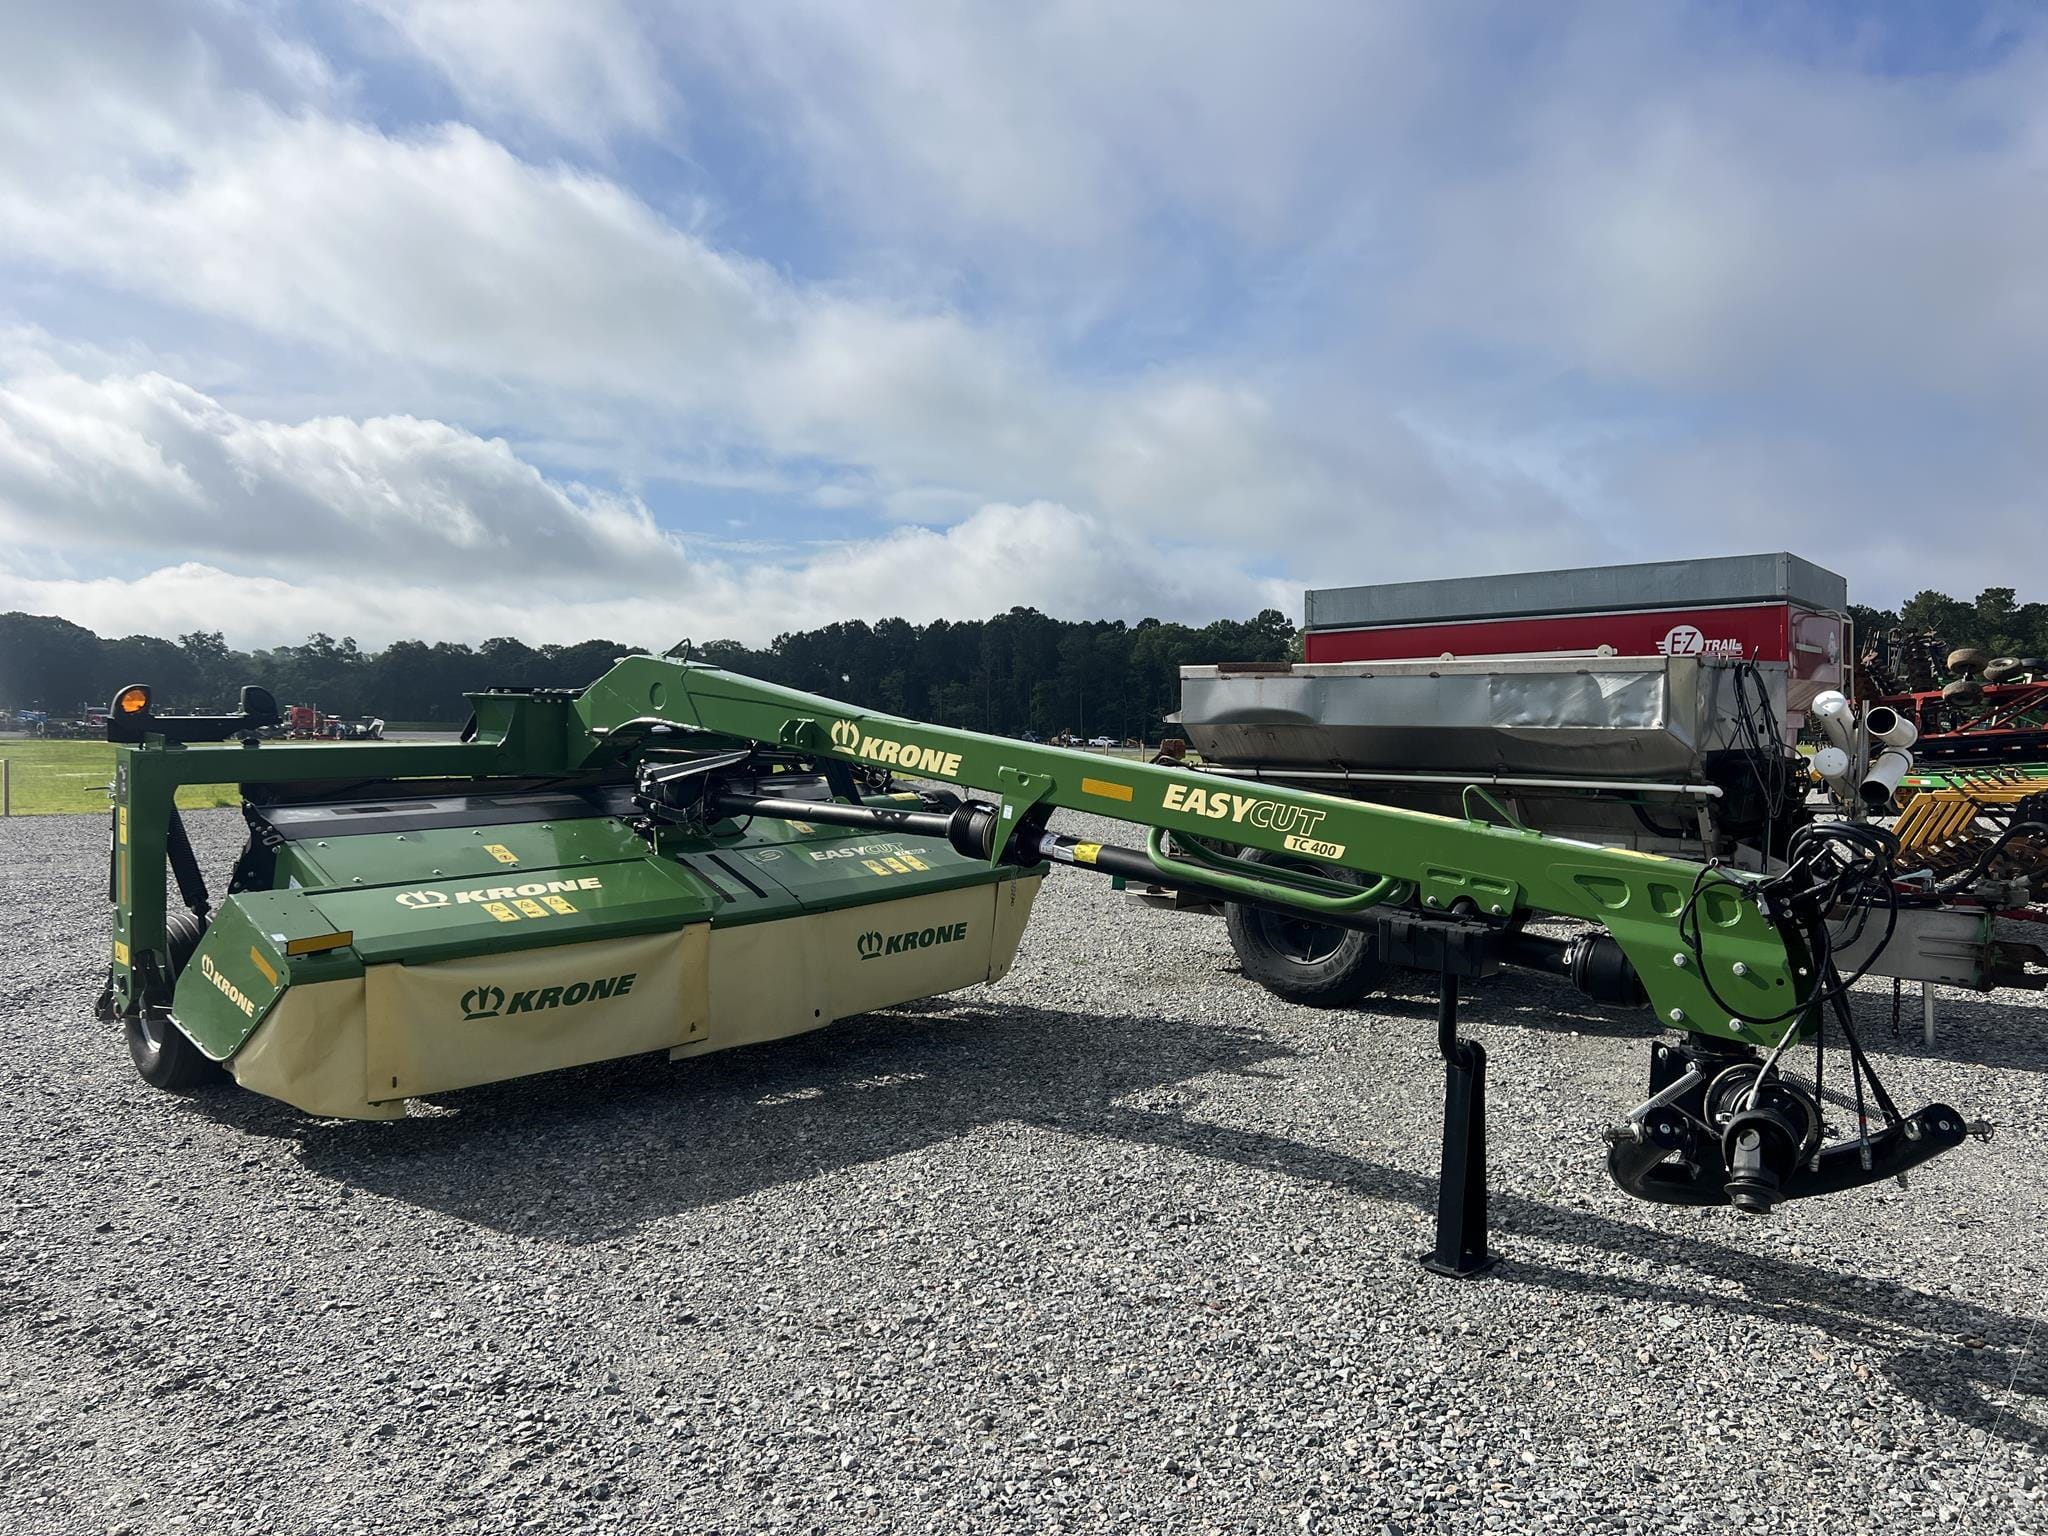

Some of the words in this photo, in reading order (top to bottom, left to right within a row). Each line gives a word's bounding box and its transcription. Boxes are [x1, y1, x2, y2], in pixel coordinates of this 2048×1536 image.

[1704, 639, 1742, 651] TRAIL
[859, 736, 963, 777] KRONE
[1162, 783, 1327, 837] EASYCUT
[809, 842, 905, 861] EASYCUT
[1292, 838, 1310, 851] TC
[1310, 842, 1337, 857] 400
[454, 877, 603, 904] KRONE
[885, 922, 968, 955] KRONE
[212, 971, 255, 1017] KRONE
[506, 973, 637, 1015] KRONE
